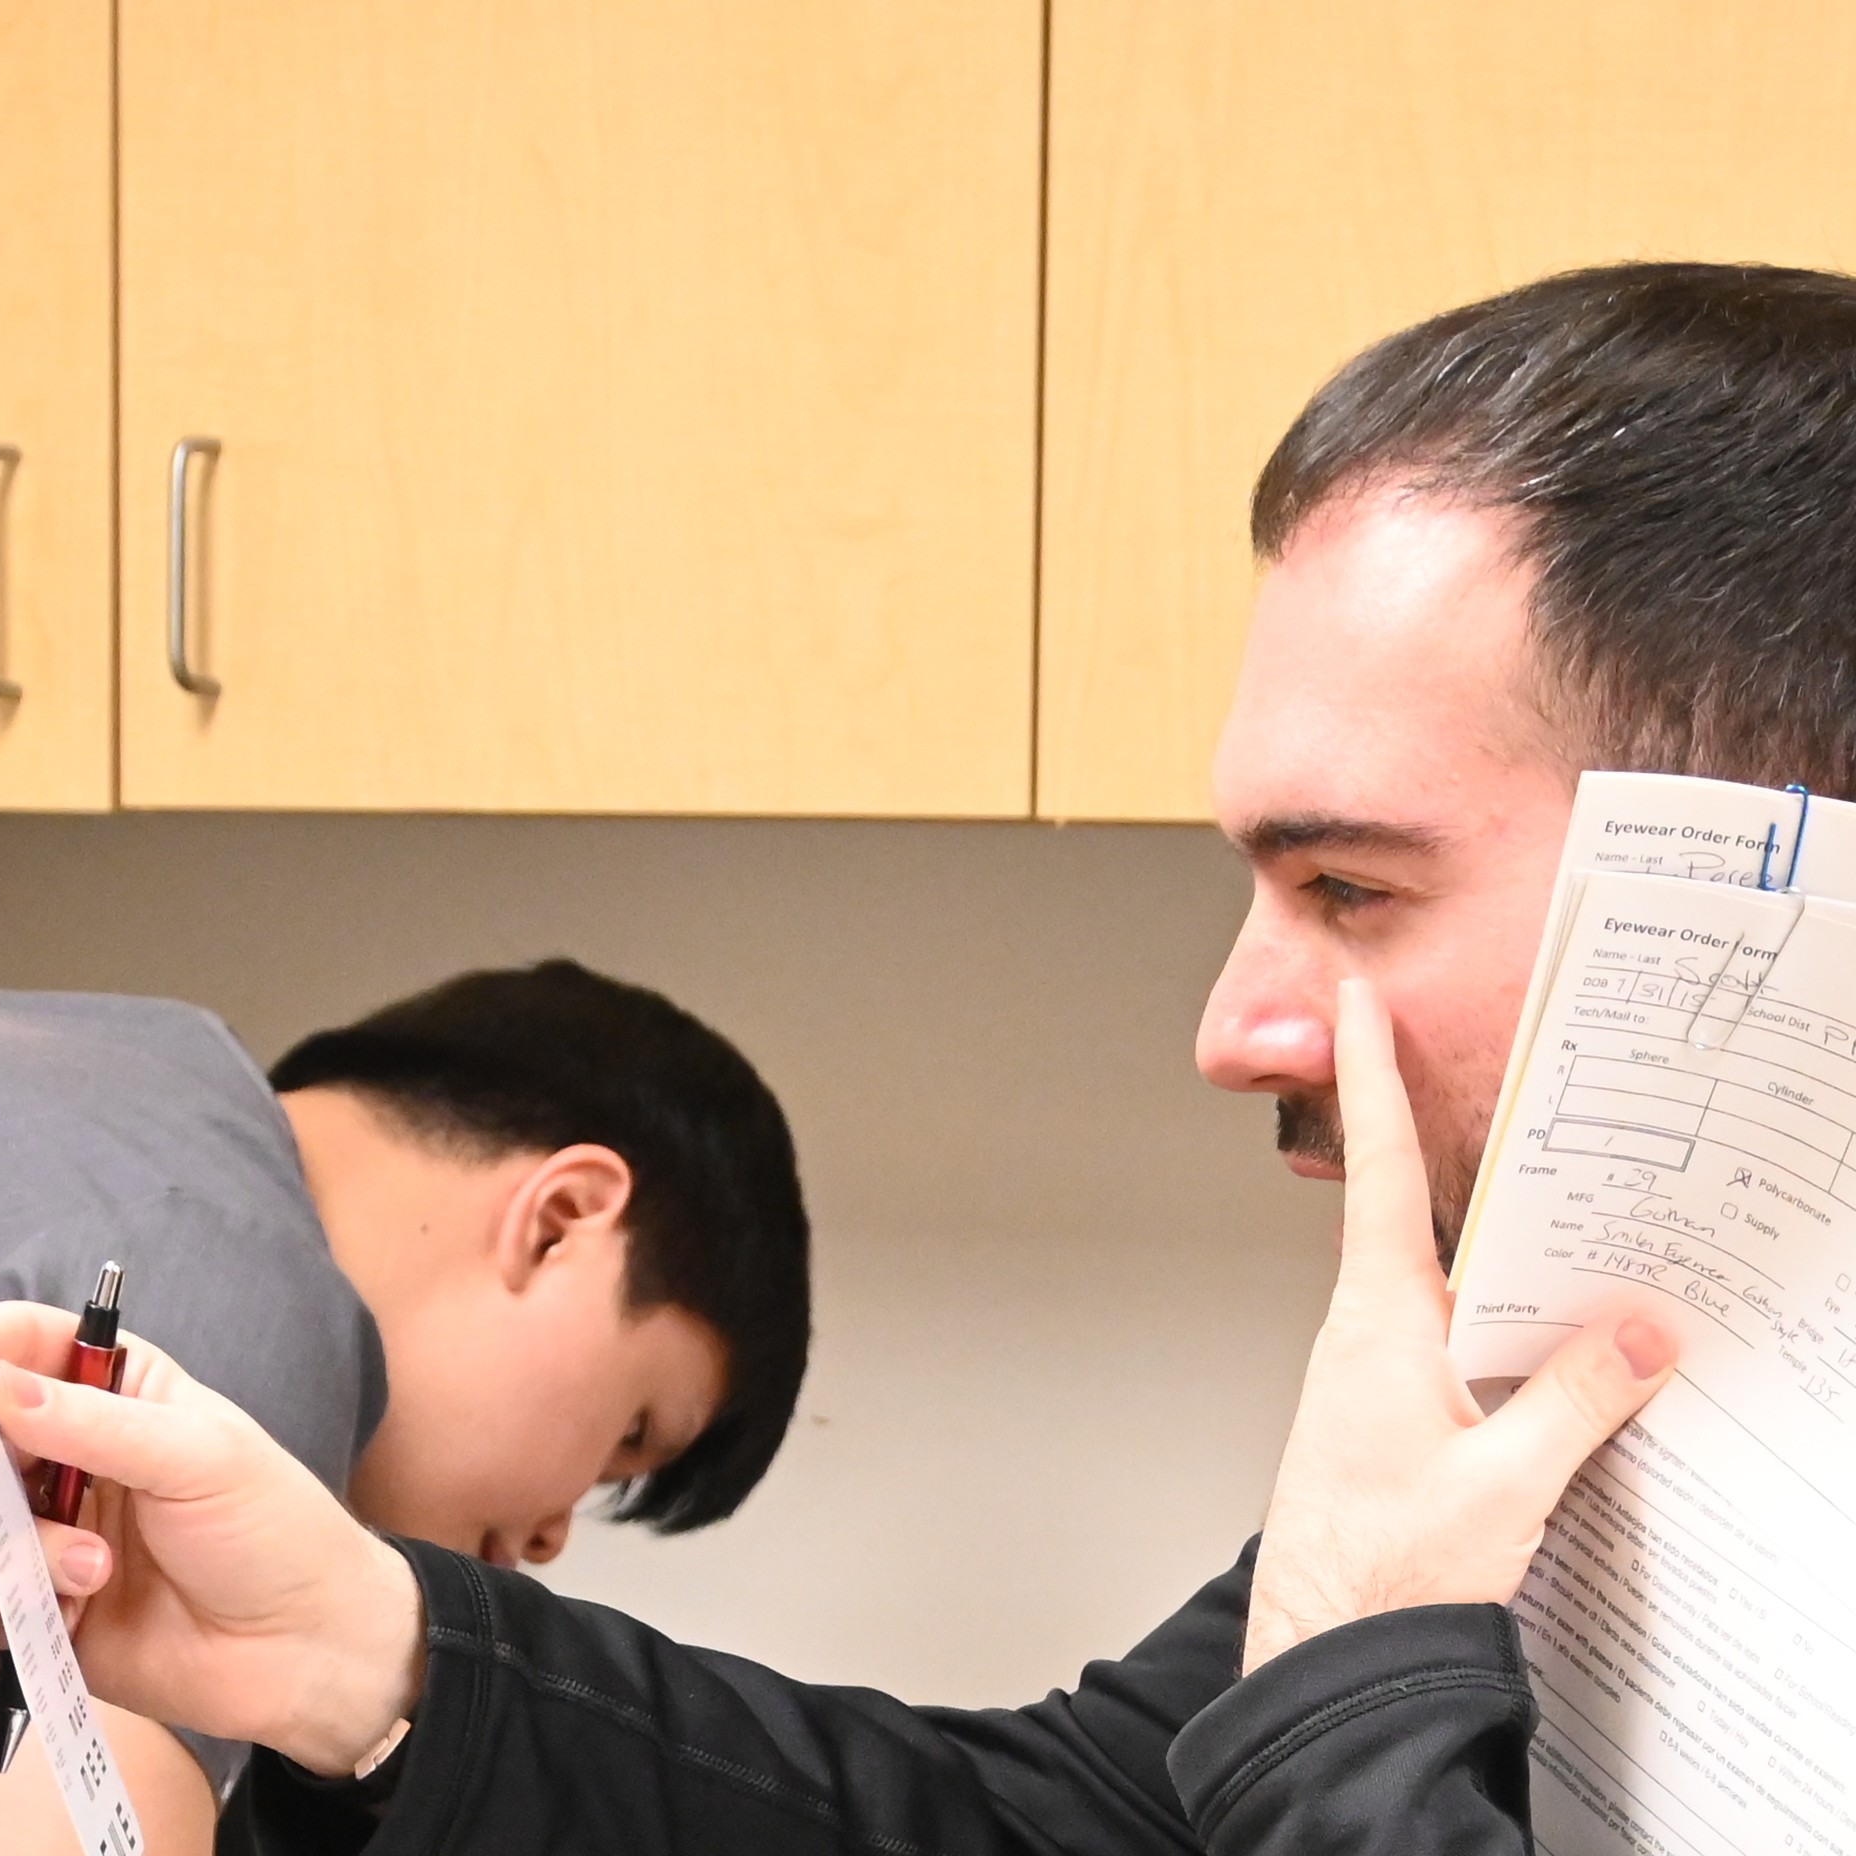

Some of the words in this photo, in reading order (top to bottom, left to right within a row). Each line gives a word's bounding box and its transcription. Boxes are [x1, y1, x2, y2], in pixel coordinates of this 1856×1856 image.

[1604, 820, 1676, 837] Eyewear
[1681, 825, 1731, 846] Order
[1595, 852, 1629, 864] Name
[1639, 854, 1663, 866] Last
[1604, 917, 1676, 938] Eyewear
[1680, 928, 1729, 950] Order
[1593, 949, 1627, 961] Name
[1637, 952, 1662, 965] Last
[1582, 976, 1609, 988] DOB
[1573, 1004, 1628, 1022] Tech/Mail
[1747, 1006, 1785, 1025] School
[1788, 1015, 1811, 1032] Dist
[1561, 1039, 1578, 1051] Rx
[1630, 1049, 1670, 1065] Sphere
[1767, 1080, 1814, 1106] Cylinder
[1527, 1129, 1545, 1140] PD
[1518, 1164, 1557, 1176] Frame
[1567, 1191, 1594, 1203] MFG
[1758, 1179, 1832, 1226] Polycarbonate
[1550, 1220, 1584, 1232] Name
[1744, 1214, 1780, 1240] Supply
[1544, 1248, 1574, 1259] Color
[1684, 1280, 1729, 1317] Blue
[1824, 1296, 1841, 1316] Eye
[1475, 1304, 1509, 1315] Third
[1512, 1303, 1540, 1317] Party
[1797, 1317, 1824, 1344] Bridge
[1778, 1345, 1807, 1374] Temple
[1638, 1564, 1651, 1580] For
[1701, 1613, 1719, 1634] Para
[1739, 1594, 1753, 1612] Yes
[1712, 1685, 1728, 1702] han
[1727, 1698, 1745, 1716] sido
[1745, 1713, 1773, 1738] usadas
[1773, 1734, 1804, 1761] durante
[1812, 1829, 1829, 1846] con
